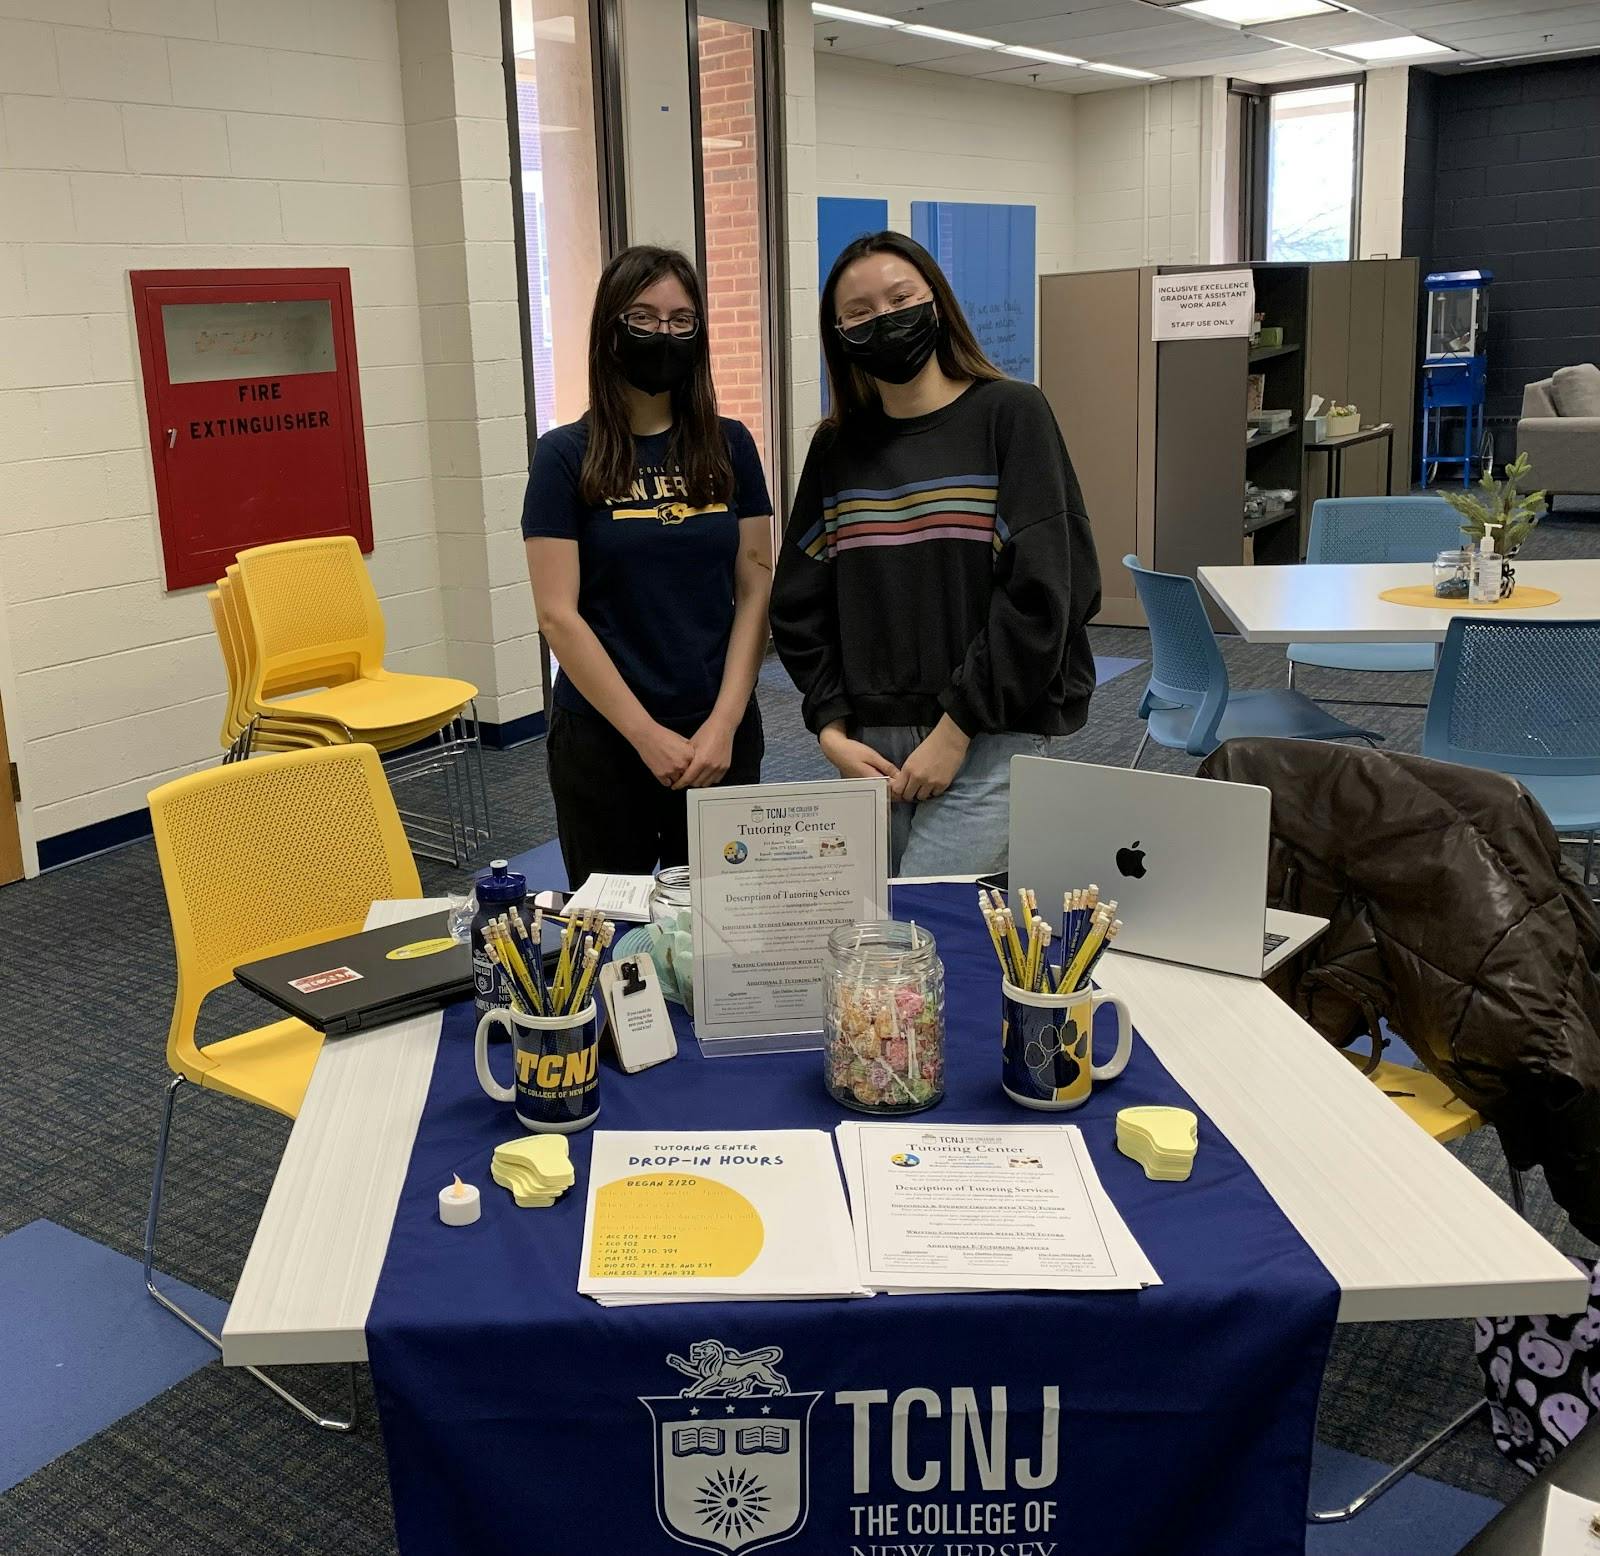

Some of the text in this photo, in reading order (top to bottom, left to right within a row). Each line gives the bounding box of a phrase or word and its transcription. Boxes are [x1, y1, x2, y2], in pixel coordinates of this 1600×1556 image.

[1158, 281, 1249, 293] INCLUSIVE EXCELLENCE
[1160, 291, 1247, 302] GRADUATE ASSISTANT
[238, 383, 282, 402] FIRE
[190, 411, 330, 439] EXTINGUISHER
[765, 807, 787, 819] TCNJ
[737, 820, 836, 837] Tutoring Center
[725, 888, 850, 903] Description of Tutoring Services
[516, 1043, 597, 1088] TCNJ
[528, 1088, 557, 1099] COLLEGE
[558, 1091, 568, 1099] OF
[569, 1088, 584, 1097] NEW
[654, 1144, 710, 1152] TUTORING
[906, 1143, 971, 1154] Tutoring
[975, 1145, 1025, 1153] Center
[628, 1155, 784, 1167] DROP-IN HOURS
[668, 1179, 697, 1187] 2/20
[894, 1184, 952, 1193] Description
[968, 1186, 1013, 1194] Tutoring
[1014, 1186, 1054, 1194] Services
[834, 1385, 1060, 1494] TCNJ
[850, 1501, 1058, 1536] THE COLLEGE OF
